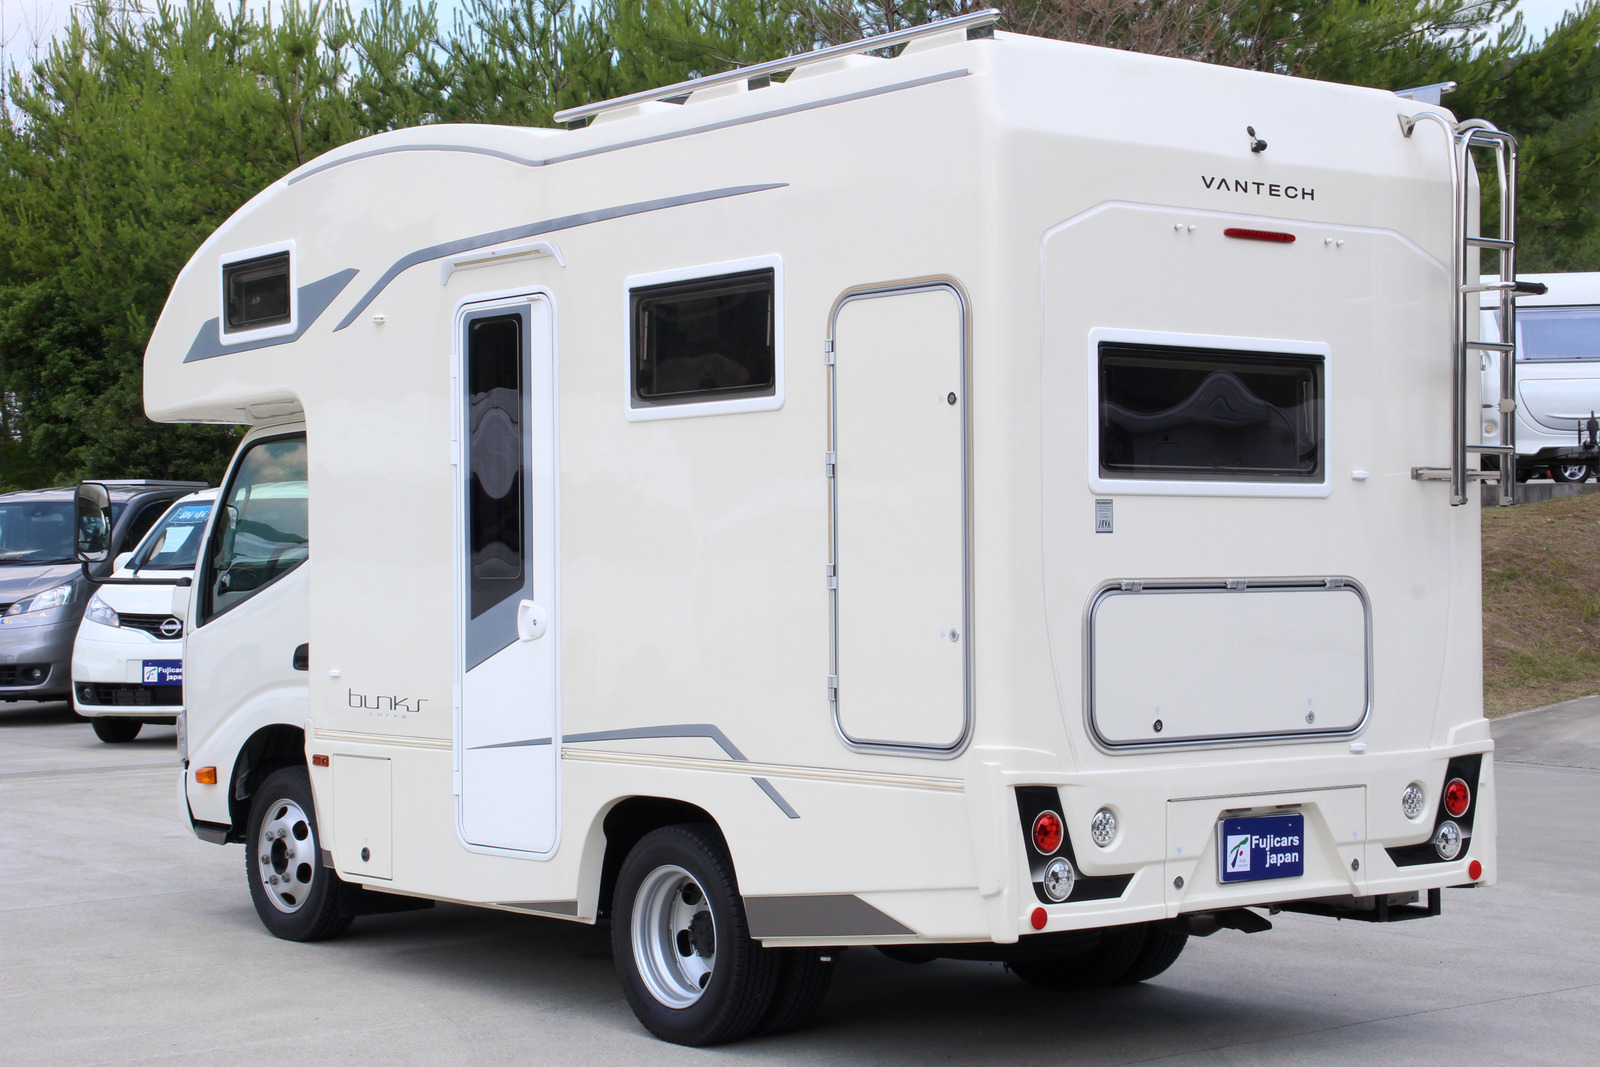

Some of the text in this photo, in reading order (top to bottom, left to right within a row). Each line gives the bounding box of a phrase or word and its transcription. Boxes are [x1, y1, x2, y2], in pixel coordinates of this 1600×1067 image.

[1201, 175, 1315, 201] VANTECH
[158, 666, 183, 674] Fujicar
[166, 672, 183, 681] japa
[348, 687, 430, 713] bunks
[1251, 834, 1300, 851] Fujicars
[1265, 851, 1299, 868] japan
